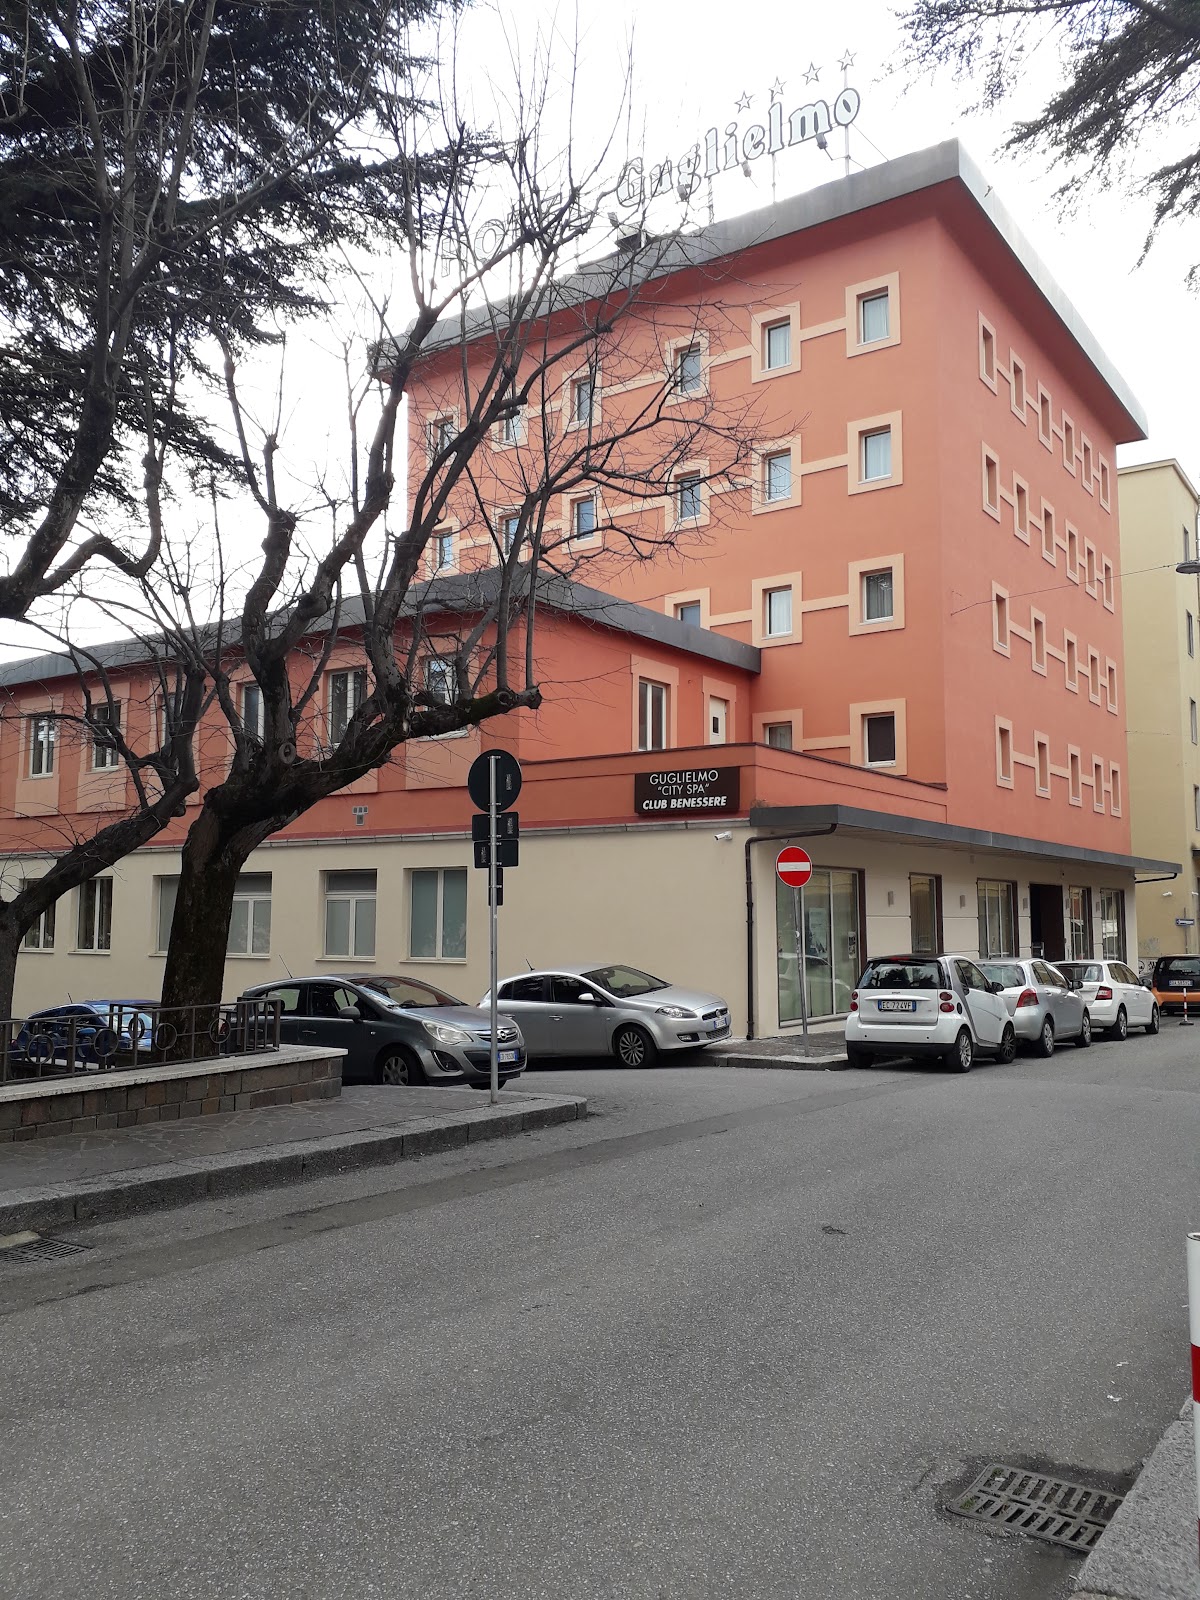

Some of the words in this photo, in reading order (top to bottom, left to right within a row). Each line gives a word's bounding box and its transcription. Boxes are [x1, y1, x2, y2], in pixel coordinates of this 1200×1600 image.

[617, 88, 860, 207] Guglielmo
[649, 769, 718, 785] GUGLIELMO
[642, 798, 667, 810] CLUB
[670, 796, 727, 808] BENESSERE
